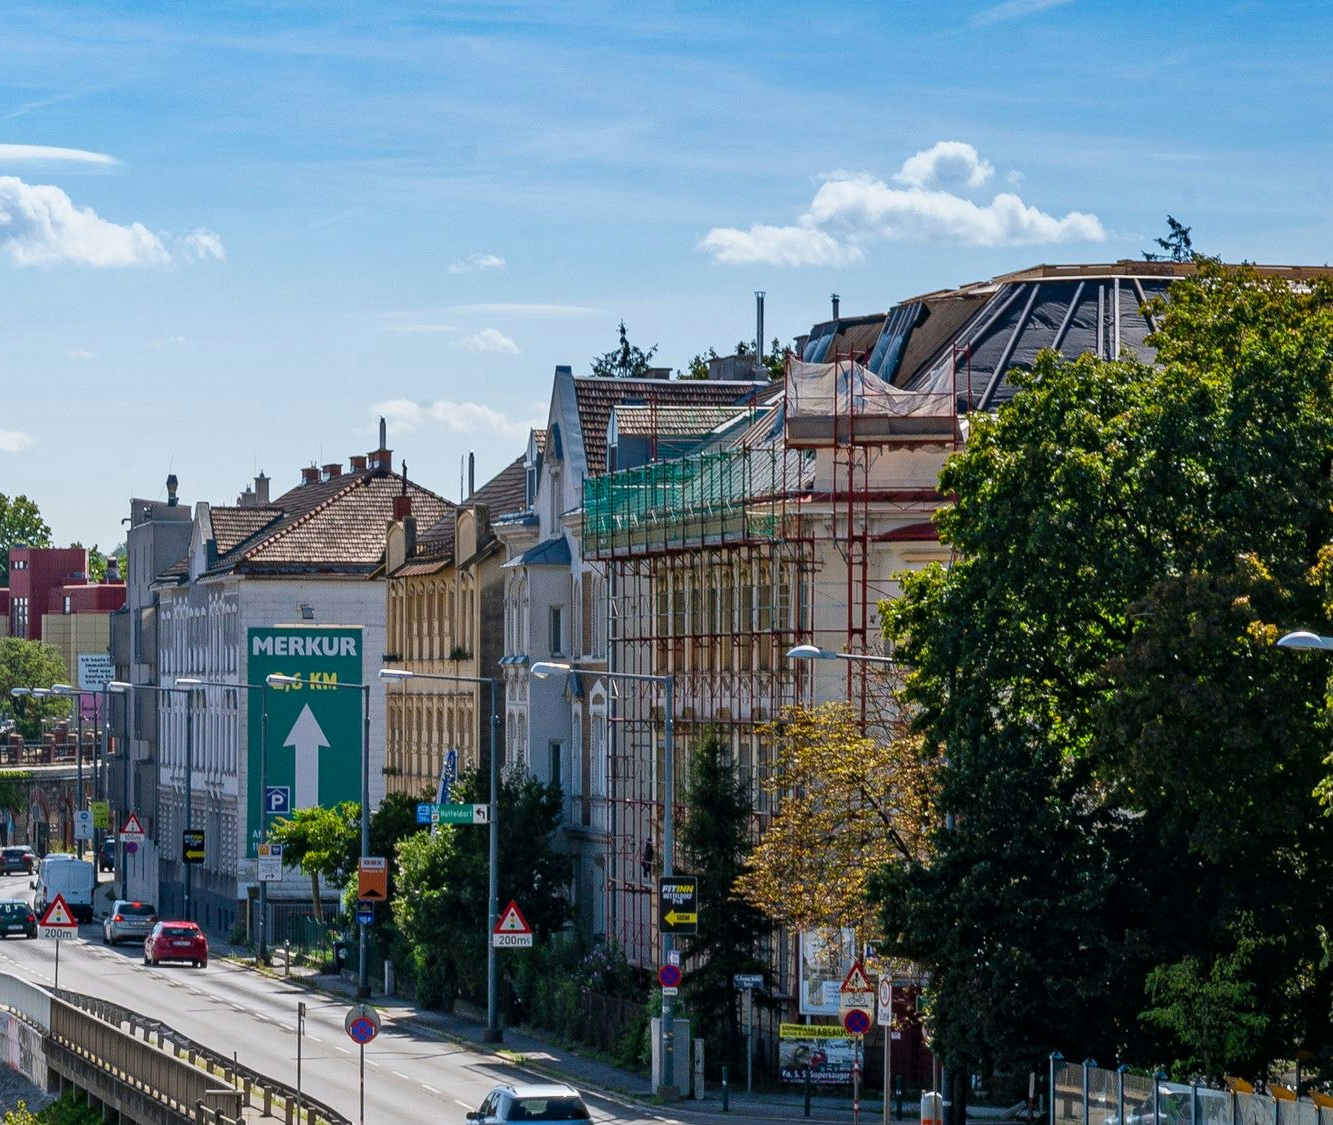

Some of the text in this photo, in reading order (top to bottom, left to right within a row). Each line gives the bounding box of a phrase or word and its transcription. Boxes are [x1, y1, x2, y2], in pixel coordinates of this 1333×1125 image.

[252, 635, 357, 656] MERKUR
[309, 672, 337, 691] KM
[440, 809, 472, 817] Hütteldorf
[662, 884, 694, 893] FITINN
[45, 928, 72, 939] 200m
[499, 935, 526, 945] 200m
[818, 1026, 862, 1038] ABSAUG
[810, 1070, 851, 1081] Supersauger
